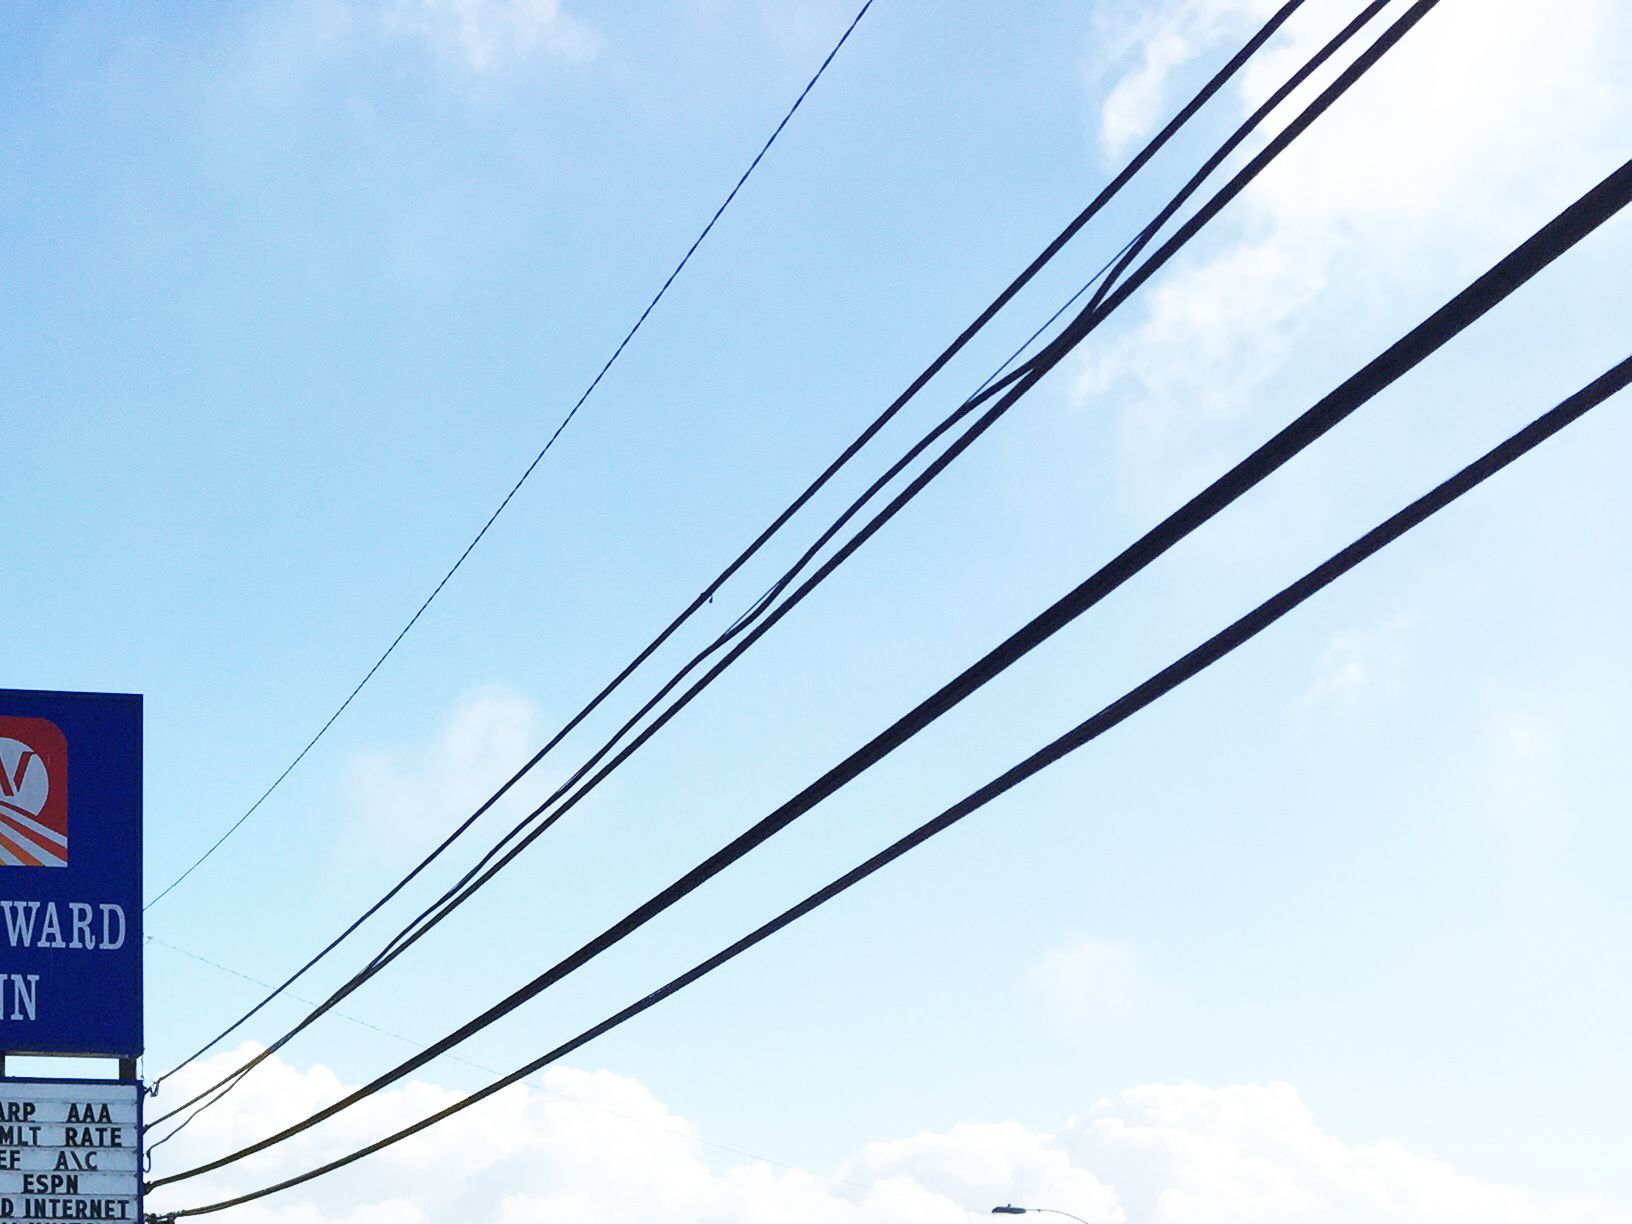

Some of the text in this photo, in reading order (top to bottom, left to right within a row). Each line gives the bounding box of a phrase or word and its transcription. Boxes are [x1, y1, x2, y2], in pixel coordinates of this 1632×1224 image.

[67, 1103, 112, 1122] AAA
[65, 1127, 122, 1147] RATE
[22, 1174, 78, 1194] ESPN
[22, 1199, 129, 1219] INTERNET
